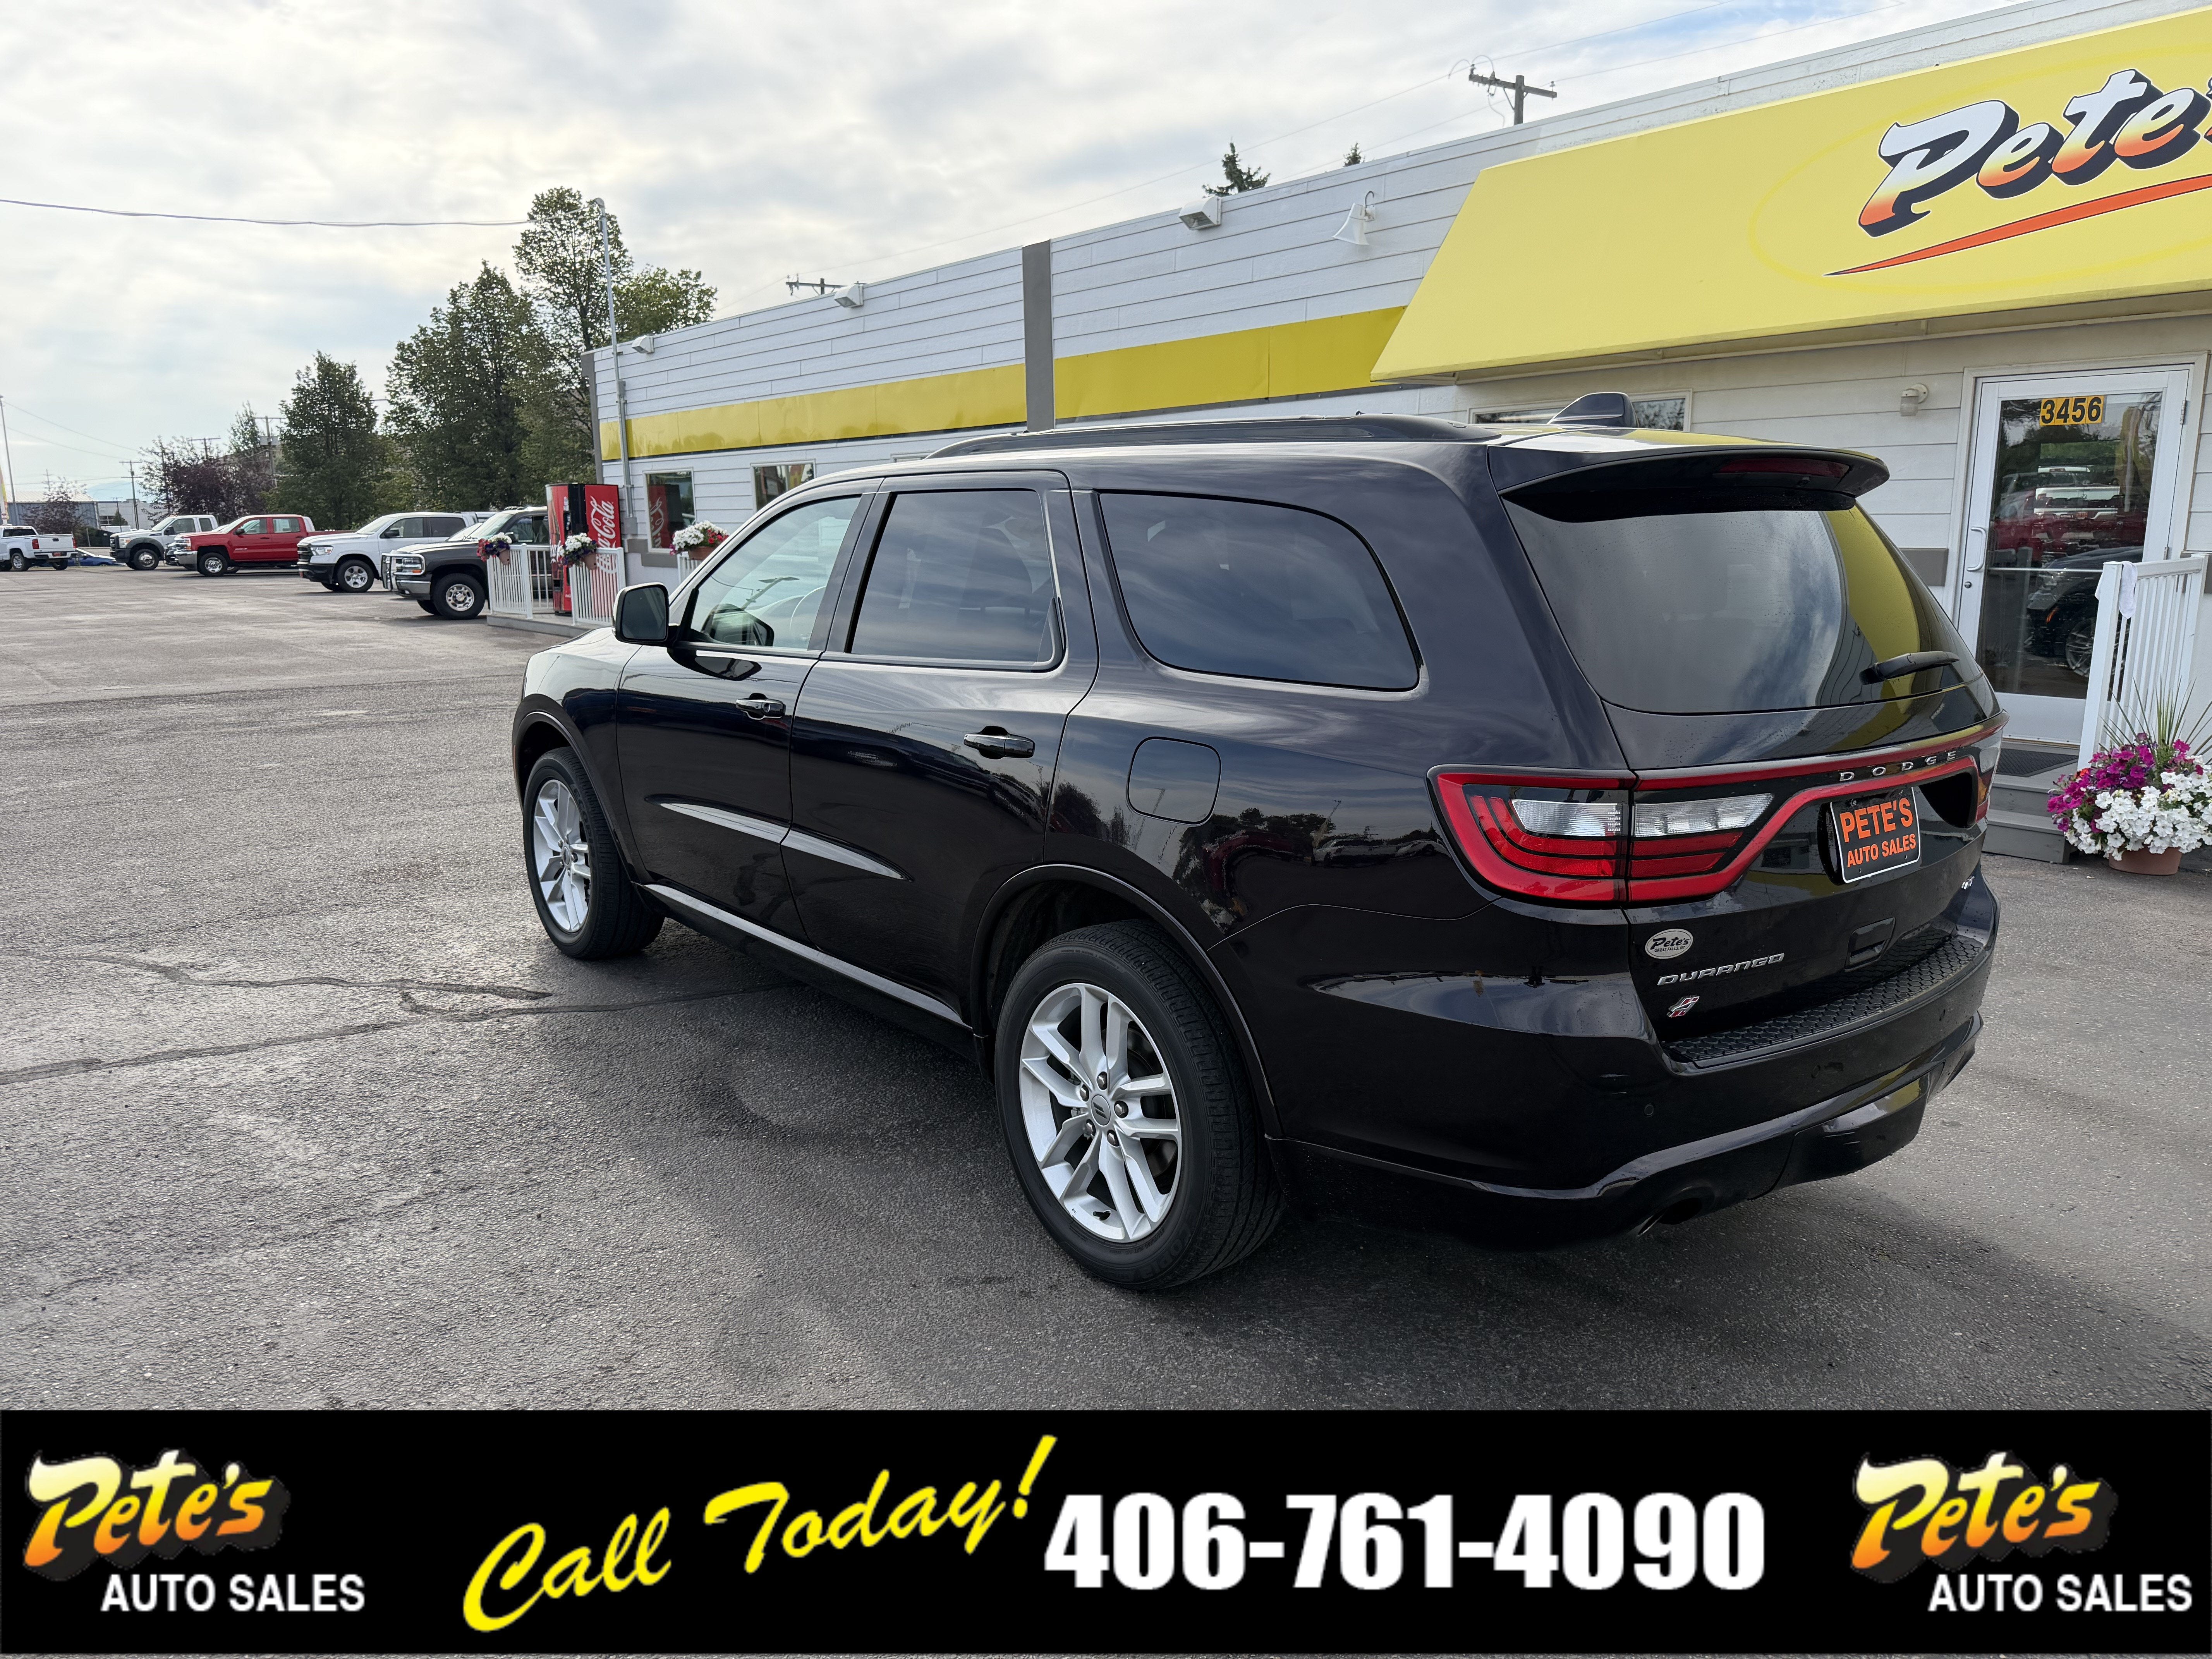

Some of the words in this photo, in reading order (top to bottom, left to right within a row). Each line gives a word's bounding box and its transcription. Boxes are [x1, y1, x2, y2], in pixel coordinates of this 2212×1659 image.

[1858, 69, 2212, 237] Pete
[2041, 397, 2102, 424] 3456
[590, 495, 617, 574] Coa-Cola
[1839, 750, 1956, 781] DODGE
[1840, 797, 1913, 843] PETE'S
[1847, 844, 1879, 867] AUTO
[1882, 833, 1916, 857] SALES
[1650, 936, 1690, 950] Pete's
[1657, 953, 1785, 986] DURANGO
